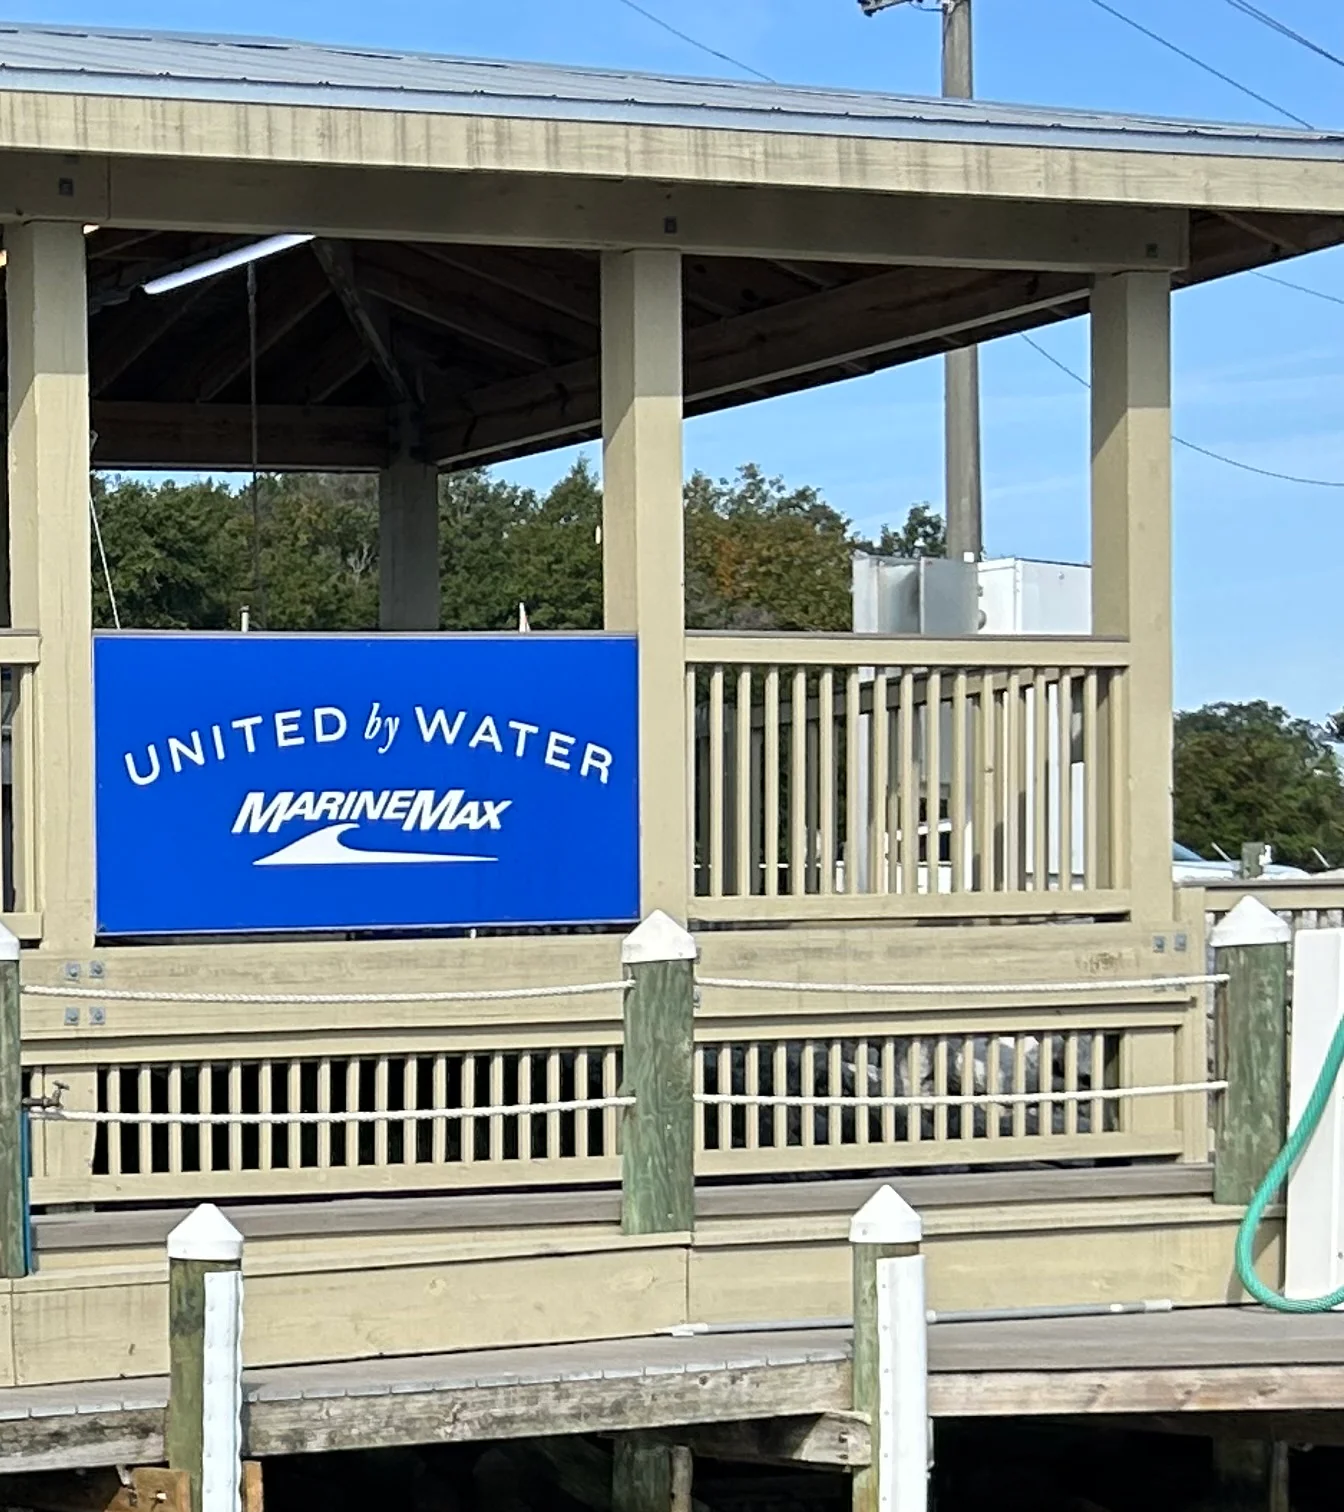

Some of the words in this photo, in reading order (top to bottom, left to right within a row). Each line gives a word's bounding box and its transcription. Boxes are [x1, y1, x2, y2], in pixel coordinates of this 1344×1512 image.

[124, 706, 348, 786] UNITED
[365, 702, 400, 754] by
[415, 706, 614, 784] WATER
